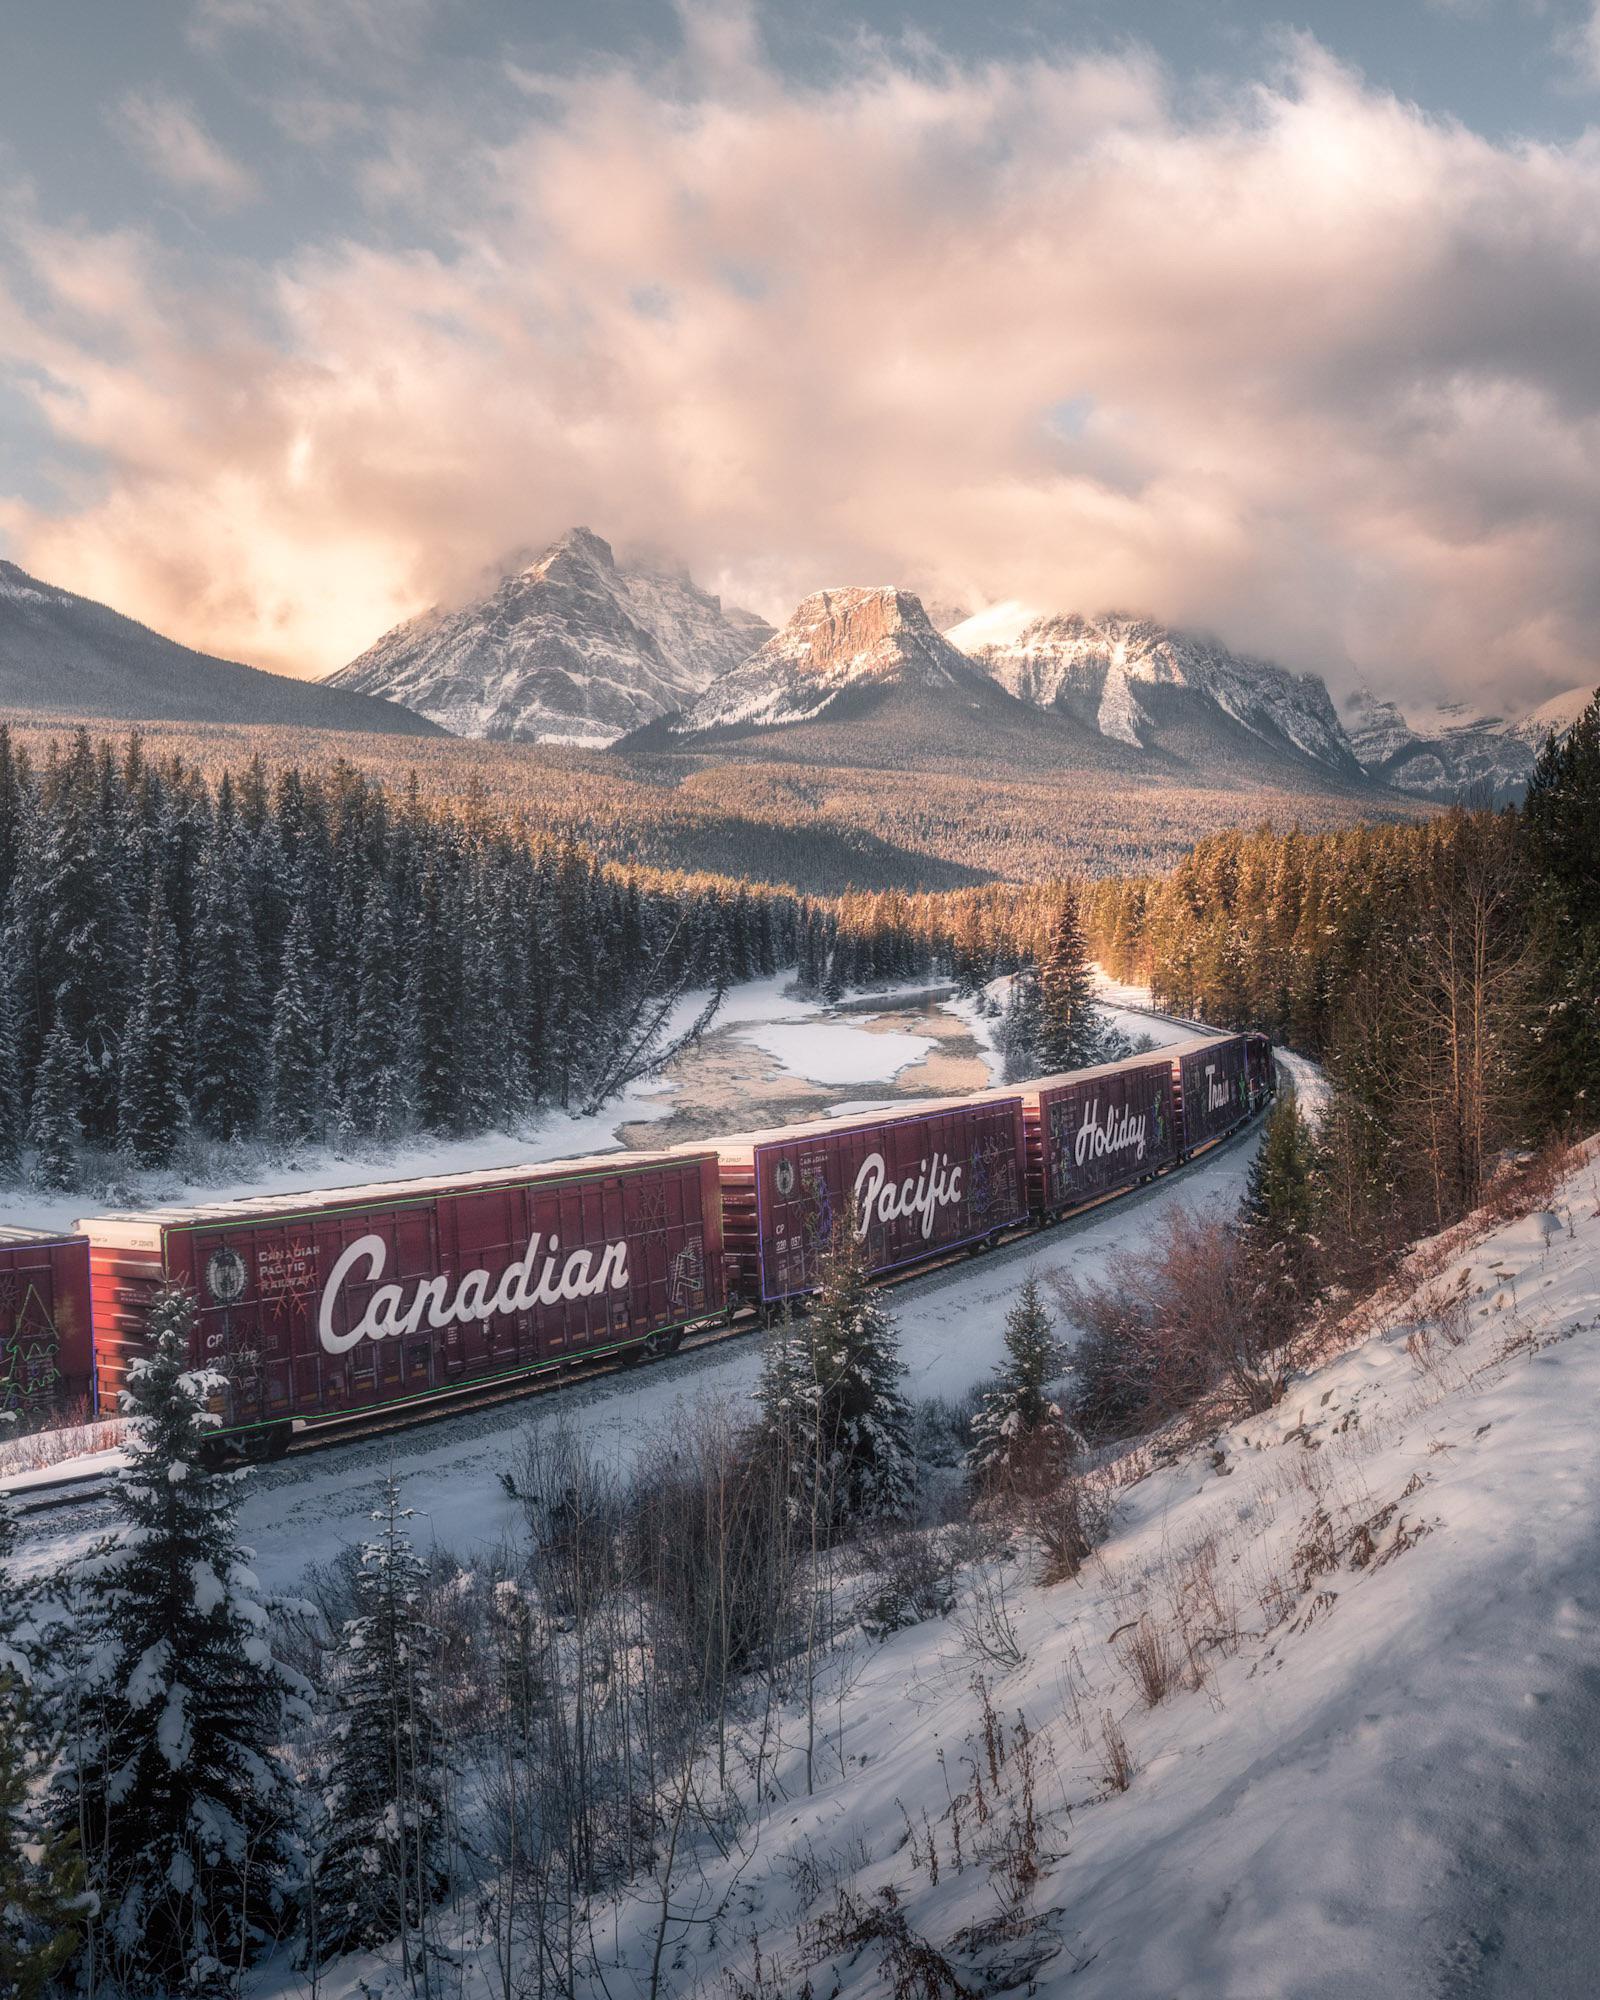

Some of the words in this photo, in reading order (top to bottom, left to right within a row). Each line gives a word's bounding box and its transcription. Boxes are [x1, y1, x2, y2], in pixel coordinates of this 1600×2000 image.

[1205, 1064, 1230, 1113] Train
[1074, 1098, 1146, 1167] Holiday
[850, 1152, 962, 1243] Pacific
[776, 1223, 785, 1235] CP
[318, 1231, 630, 1355] Canadian
[206, 1333, 224, 1348] CP
